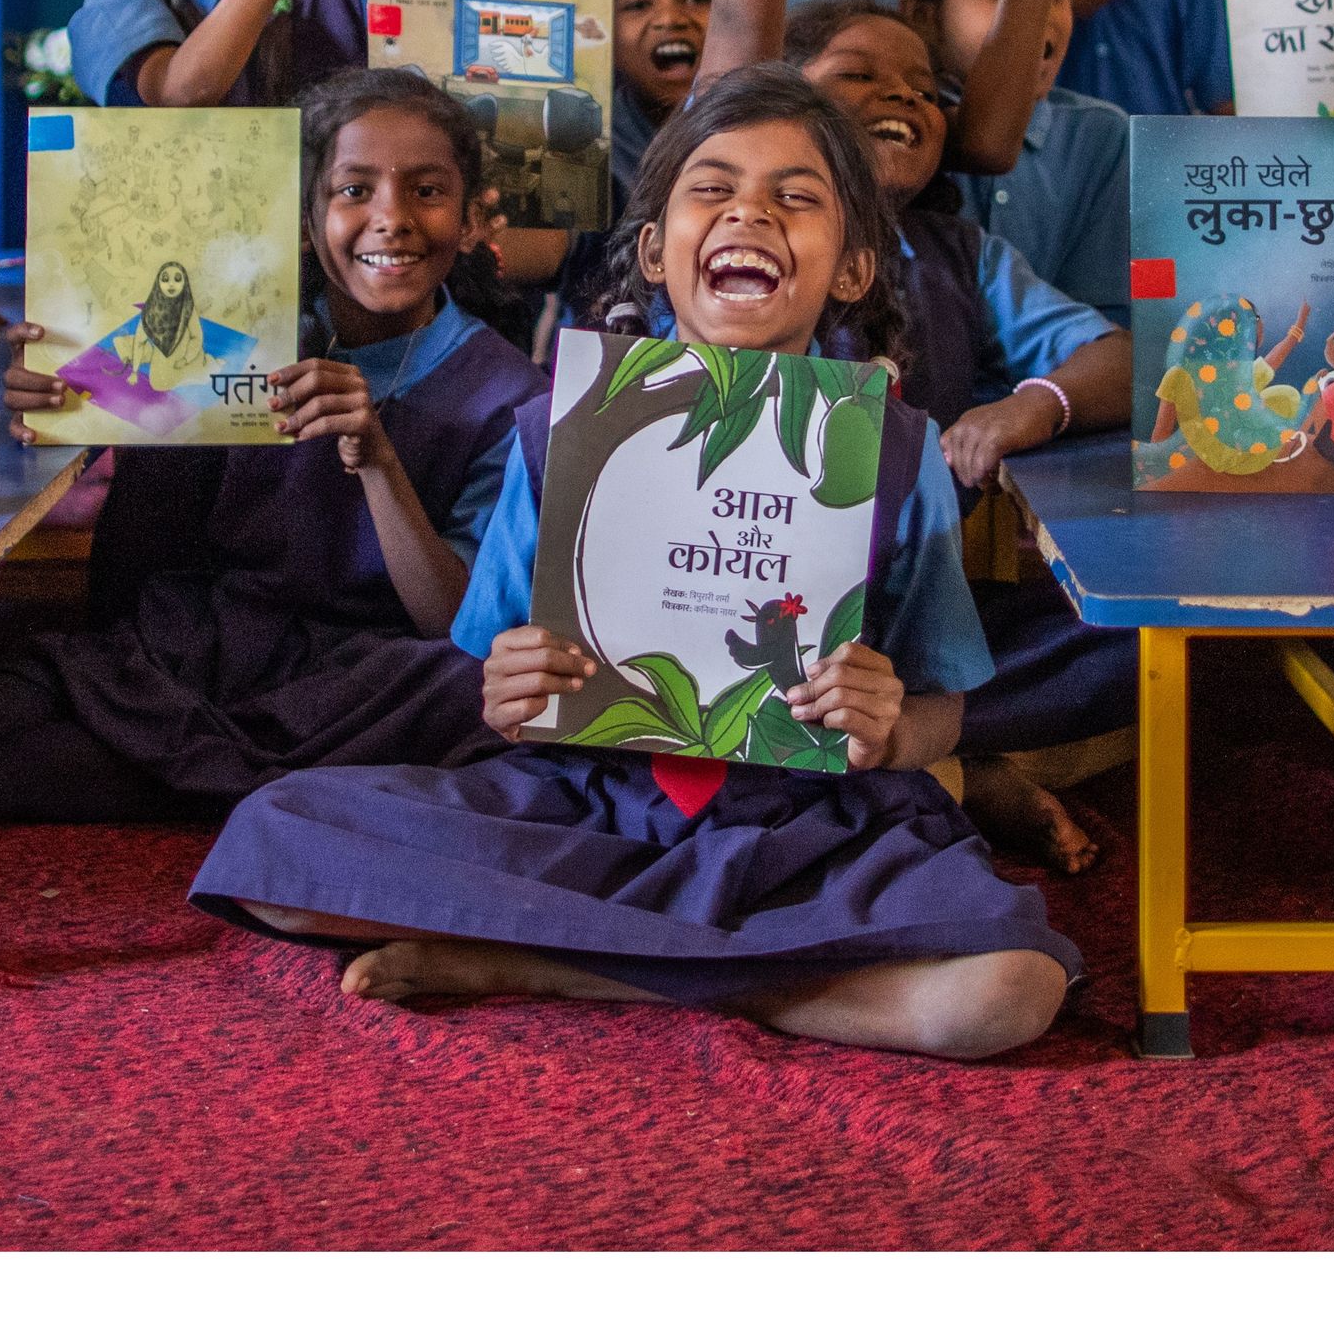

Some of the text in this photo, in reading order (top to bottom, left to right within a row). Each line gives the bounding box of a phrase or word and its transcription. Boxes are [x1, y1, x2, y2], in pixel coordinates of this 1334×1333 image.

[1262, 25, 1308, 54] का
[1183, 154, 1313, 194] ख़ुशी खेले
[209, 364, 280, 406] पतंग
[712, 488, 798, 525] आम
[737, 525, 774, 549] और
[667, 530, 792, 584] कोयल
[661, 600, 693, 614] चित्रकार:
[693, 603, 719, 616] कनिका
[662, 586, 731, 604] लेखक: त्रिपुरारी शर्मा
